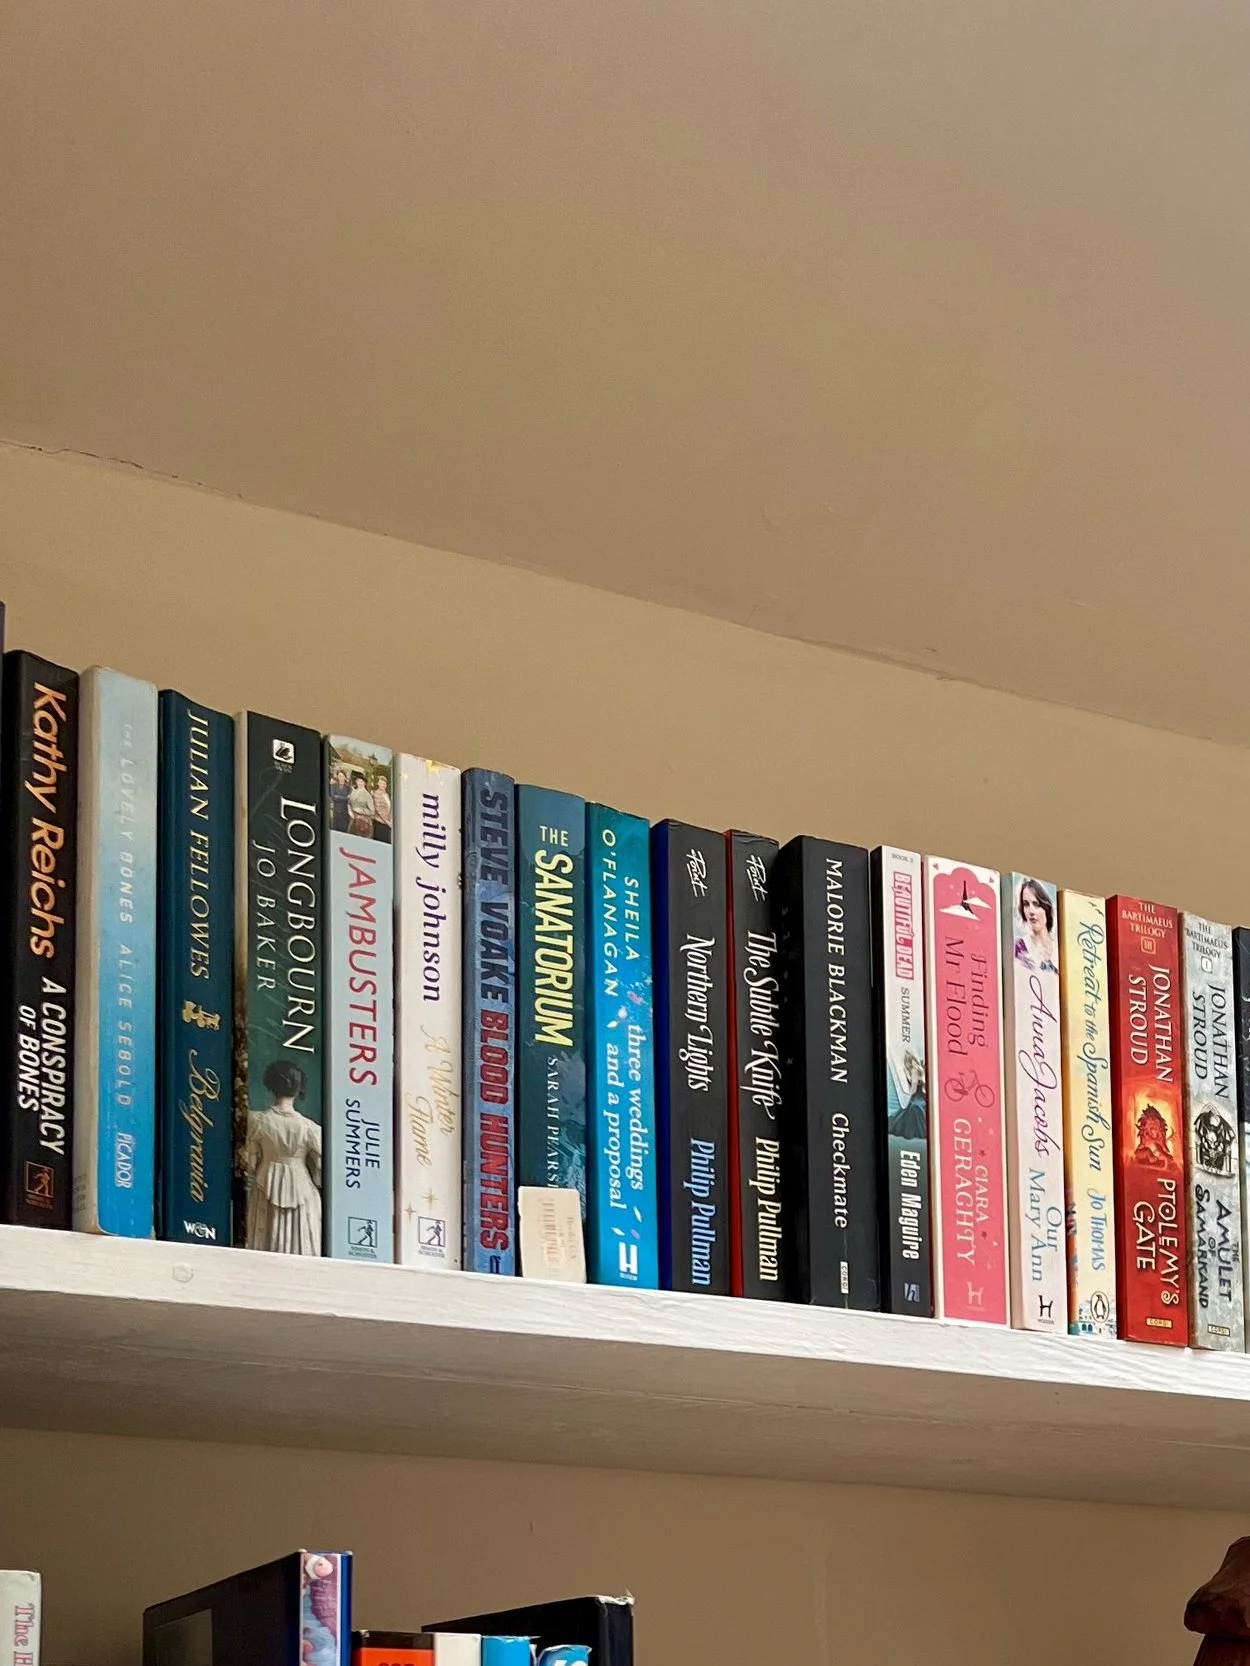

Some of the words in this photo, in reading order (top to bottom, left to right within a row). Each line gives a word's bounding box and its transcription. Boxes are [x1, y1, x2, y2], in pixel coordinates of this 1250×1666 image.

[24, 681, 67, 814] Kathy
[187, 708, 209, 820] JULIAN
[251, 839, 276, 878] JO
[415, 791, 447, 869] milly
[479, 786, 509, 888] STEVE
[540, 824, 569, 848] THE
[29, 816, 66, 959] Reichs
[189, 829, 210, 980] FELLOWES
[280, 795, 317, 1055] LONGBOURN
[601, 828, 618, 998] O'FLANAGAN
[624, 875, 641, 962] SHEILA
[825, 857, 845, 956] MALORIE
[41, 976, 68, 994] A
[256, 893, 277, 992] BAKER
[338, 846, 378, 1087] JAMBUSTERS
[415, 876, 447, 1003] johnson
[480, 902, 509, 1003] VOAKE
[534, 849, 575, 1048] SANATORIUM
[743, 930, 778, 967] The
[20, 1004, 37, 1031] OF
[743, 966, 780, 1038] Subtle
[827, 963, 849, 1084] BLACKMAN
[1127, 973, 1149, 1066] STROUD
[1149, 962, 1174, 1084] JONATHAN
[18, 1036, 40, 1113] BONES
[40, 1003, 67, 1156] CONSPIRACY
[479, 1009, 510, 1105] BLOOD
[740, 1037, 783, 1120] Knife
[345, 1098, 361, 1190] SUMMERS
[362, 1117, 380, 1170] JULIE
[480, 1112, 510, 1251] HUNTERS
[749, 1135, 780, 1198] Philip
[831, 1112, 851, 1229] Checkmate
[899, 1149, 920, 1188] Eden
[953, 1117, 976, 1265] GERAGHTY
[757, 1199, 782, 1282] Pullman
[898, 1191, 922, 1261] Maguire
[974, 1164, 990, 1224] CIARA
[1132, 1200, 1157, 1272] GATE
[1157, 1177, 1180, 1306] PTOLEMY'S
